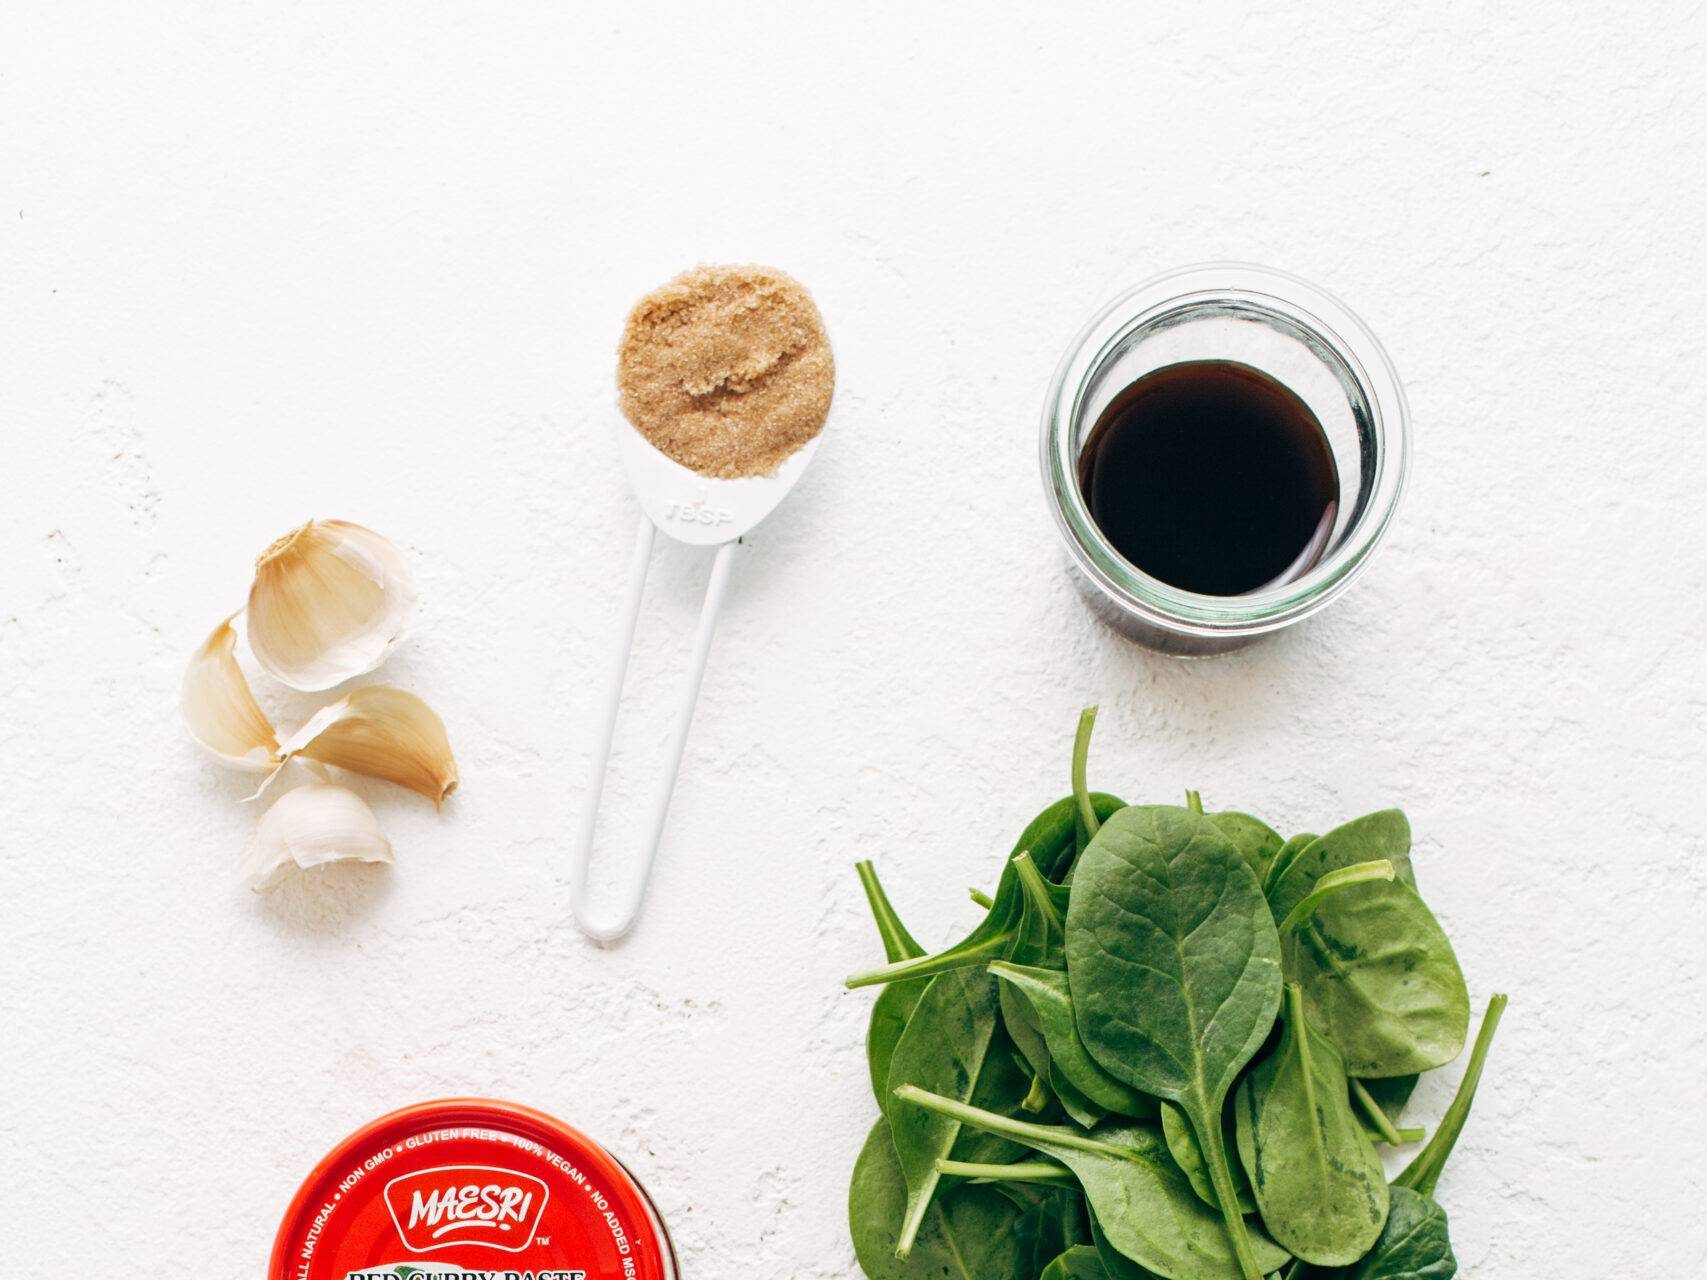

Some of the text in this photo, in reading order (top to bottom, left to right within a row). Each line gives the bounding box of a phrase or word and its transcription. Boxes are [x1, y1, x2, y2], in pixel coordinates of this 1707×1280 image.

[664, 501, 735, 527] TBSP
[301, 1202, 336, 1259] NATURAL
[339, 1167, 365, 1193] NON
[364, 1148, 393, 1170] GMO
[406, 1128, 459, 1149] GLUTEN
[462, 1127, 498, 1142] FREE
[512, 1137, 544, 1156] 100%
[546, 1150, 586, 1185] VEGAN
[590, 1190, 608, 1210] NO
[603, 1211, 630, 1255] ADDED
[408, 1184, 532, 1230] MAESRI
